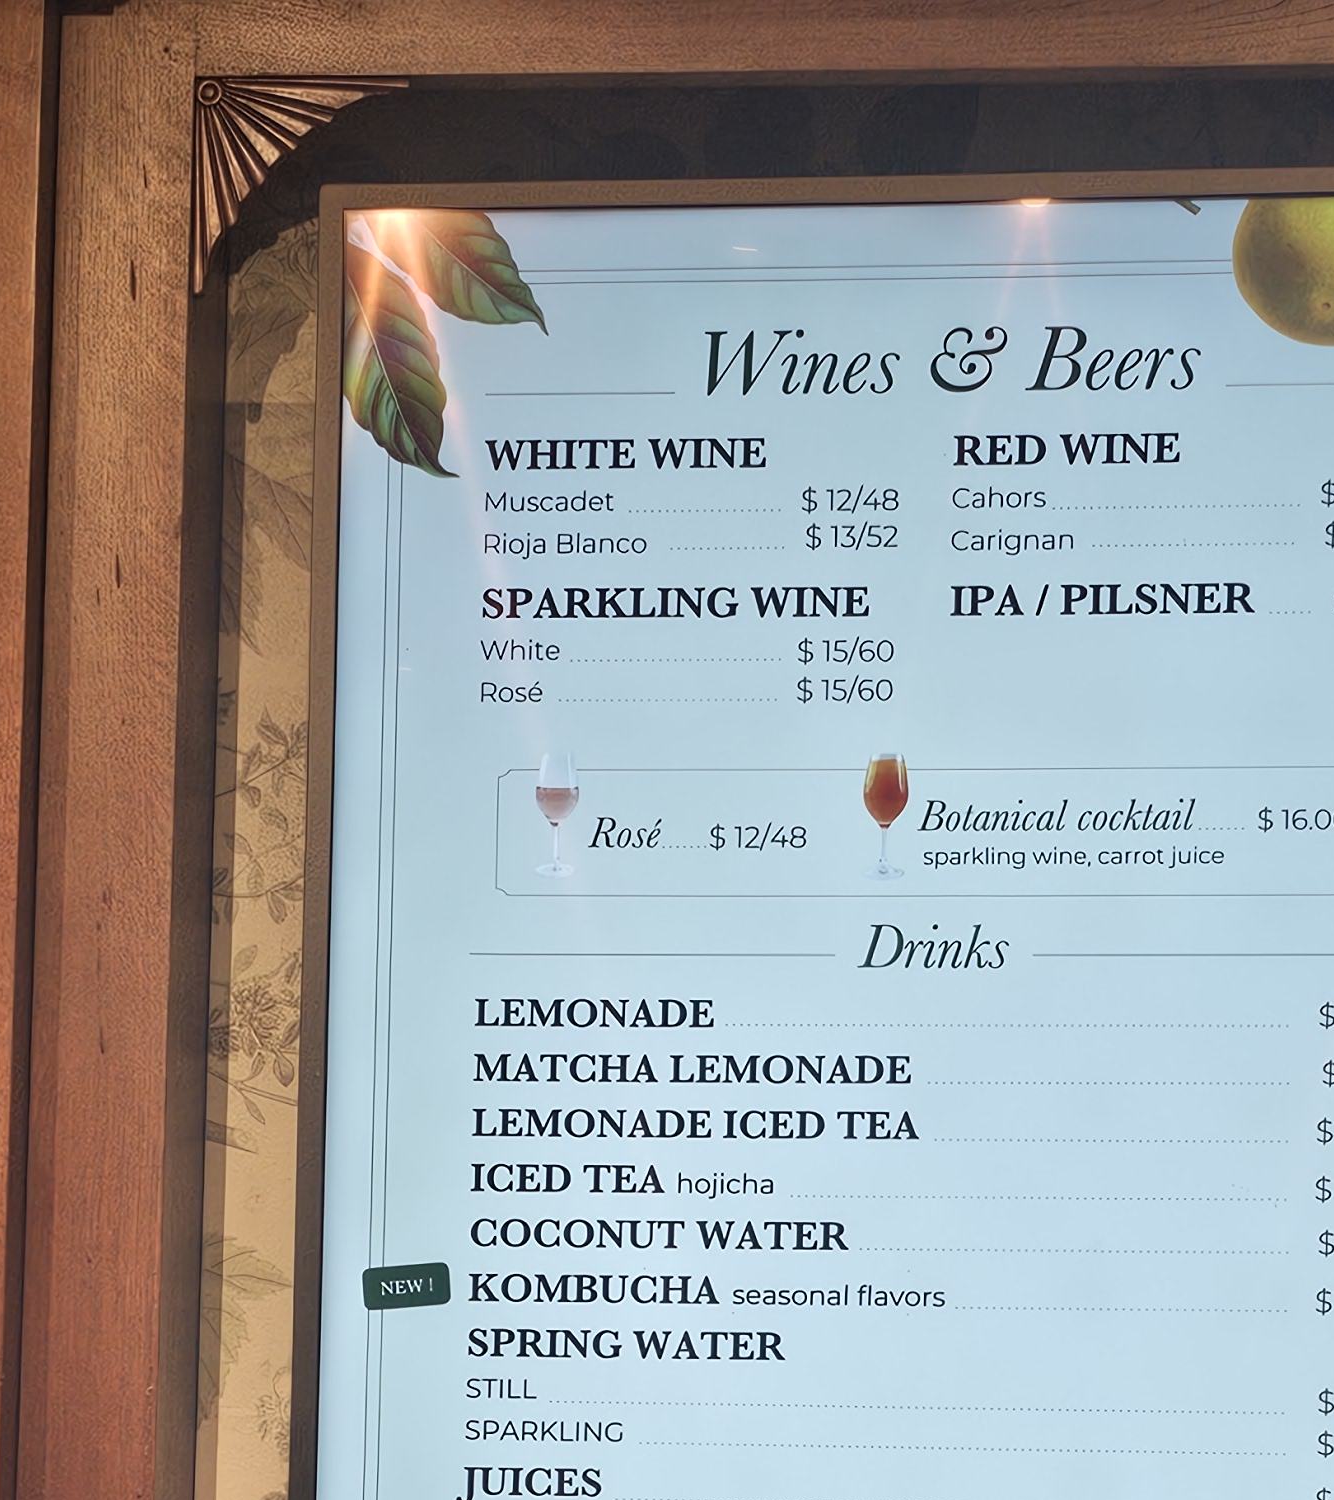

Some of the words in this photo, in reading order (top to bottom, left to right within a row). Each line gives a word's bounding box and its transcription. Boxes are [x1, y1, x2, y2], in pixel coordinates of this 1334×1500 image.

[704, 327, 901, 397] Wines
[930, 324, 1008, 393] &
[1024, 324, 1202, 391] Beers
[484, 437, 636, 472] WHITE
[647, 436, 767, 470] WINE
[485, 488, 615, 513] Muscadet
[952, 484, 1047, 509] Cahors
[484, 531, 546, 560] Rioja
[556, 531, 648, 555] Blanco
[951, 527, 1074, 556] Carignan
[482, 585, 739, 620] SPARKLING
[750, 585, 870, 619] WINE
[949, 582, 1025, 617] IPA
[1035, 582, 1050, 617] /
[1059, 581, 1256, 616] PILSNER
[917, 797, 1069, 833] Botanical
[1077, 796, 1196, 832] cocktail
[923, 845, 1026, 870] sparkling
[1032, 849, 1092, 868] wine,
[1097, 848, 1164, 865] carrot
[1168, 844, 1225, 869] juice
[857, 922, 1010, 970] Drinks
[470, 1162, 572, 1193] ICED
[582, 1163, 666, 1194] TEA
[677, 1170, 774, 1200] hojicha
[381, 1278, 423, 1296] NEW
[467, 1272, 720, 1305] KOMBUCHA
[732, 1283, 849, 1307] seasonal
[856, 1283, 946, 1308] flavors
